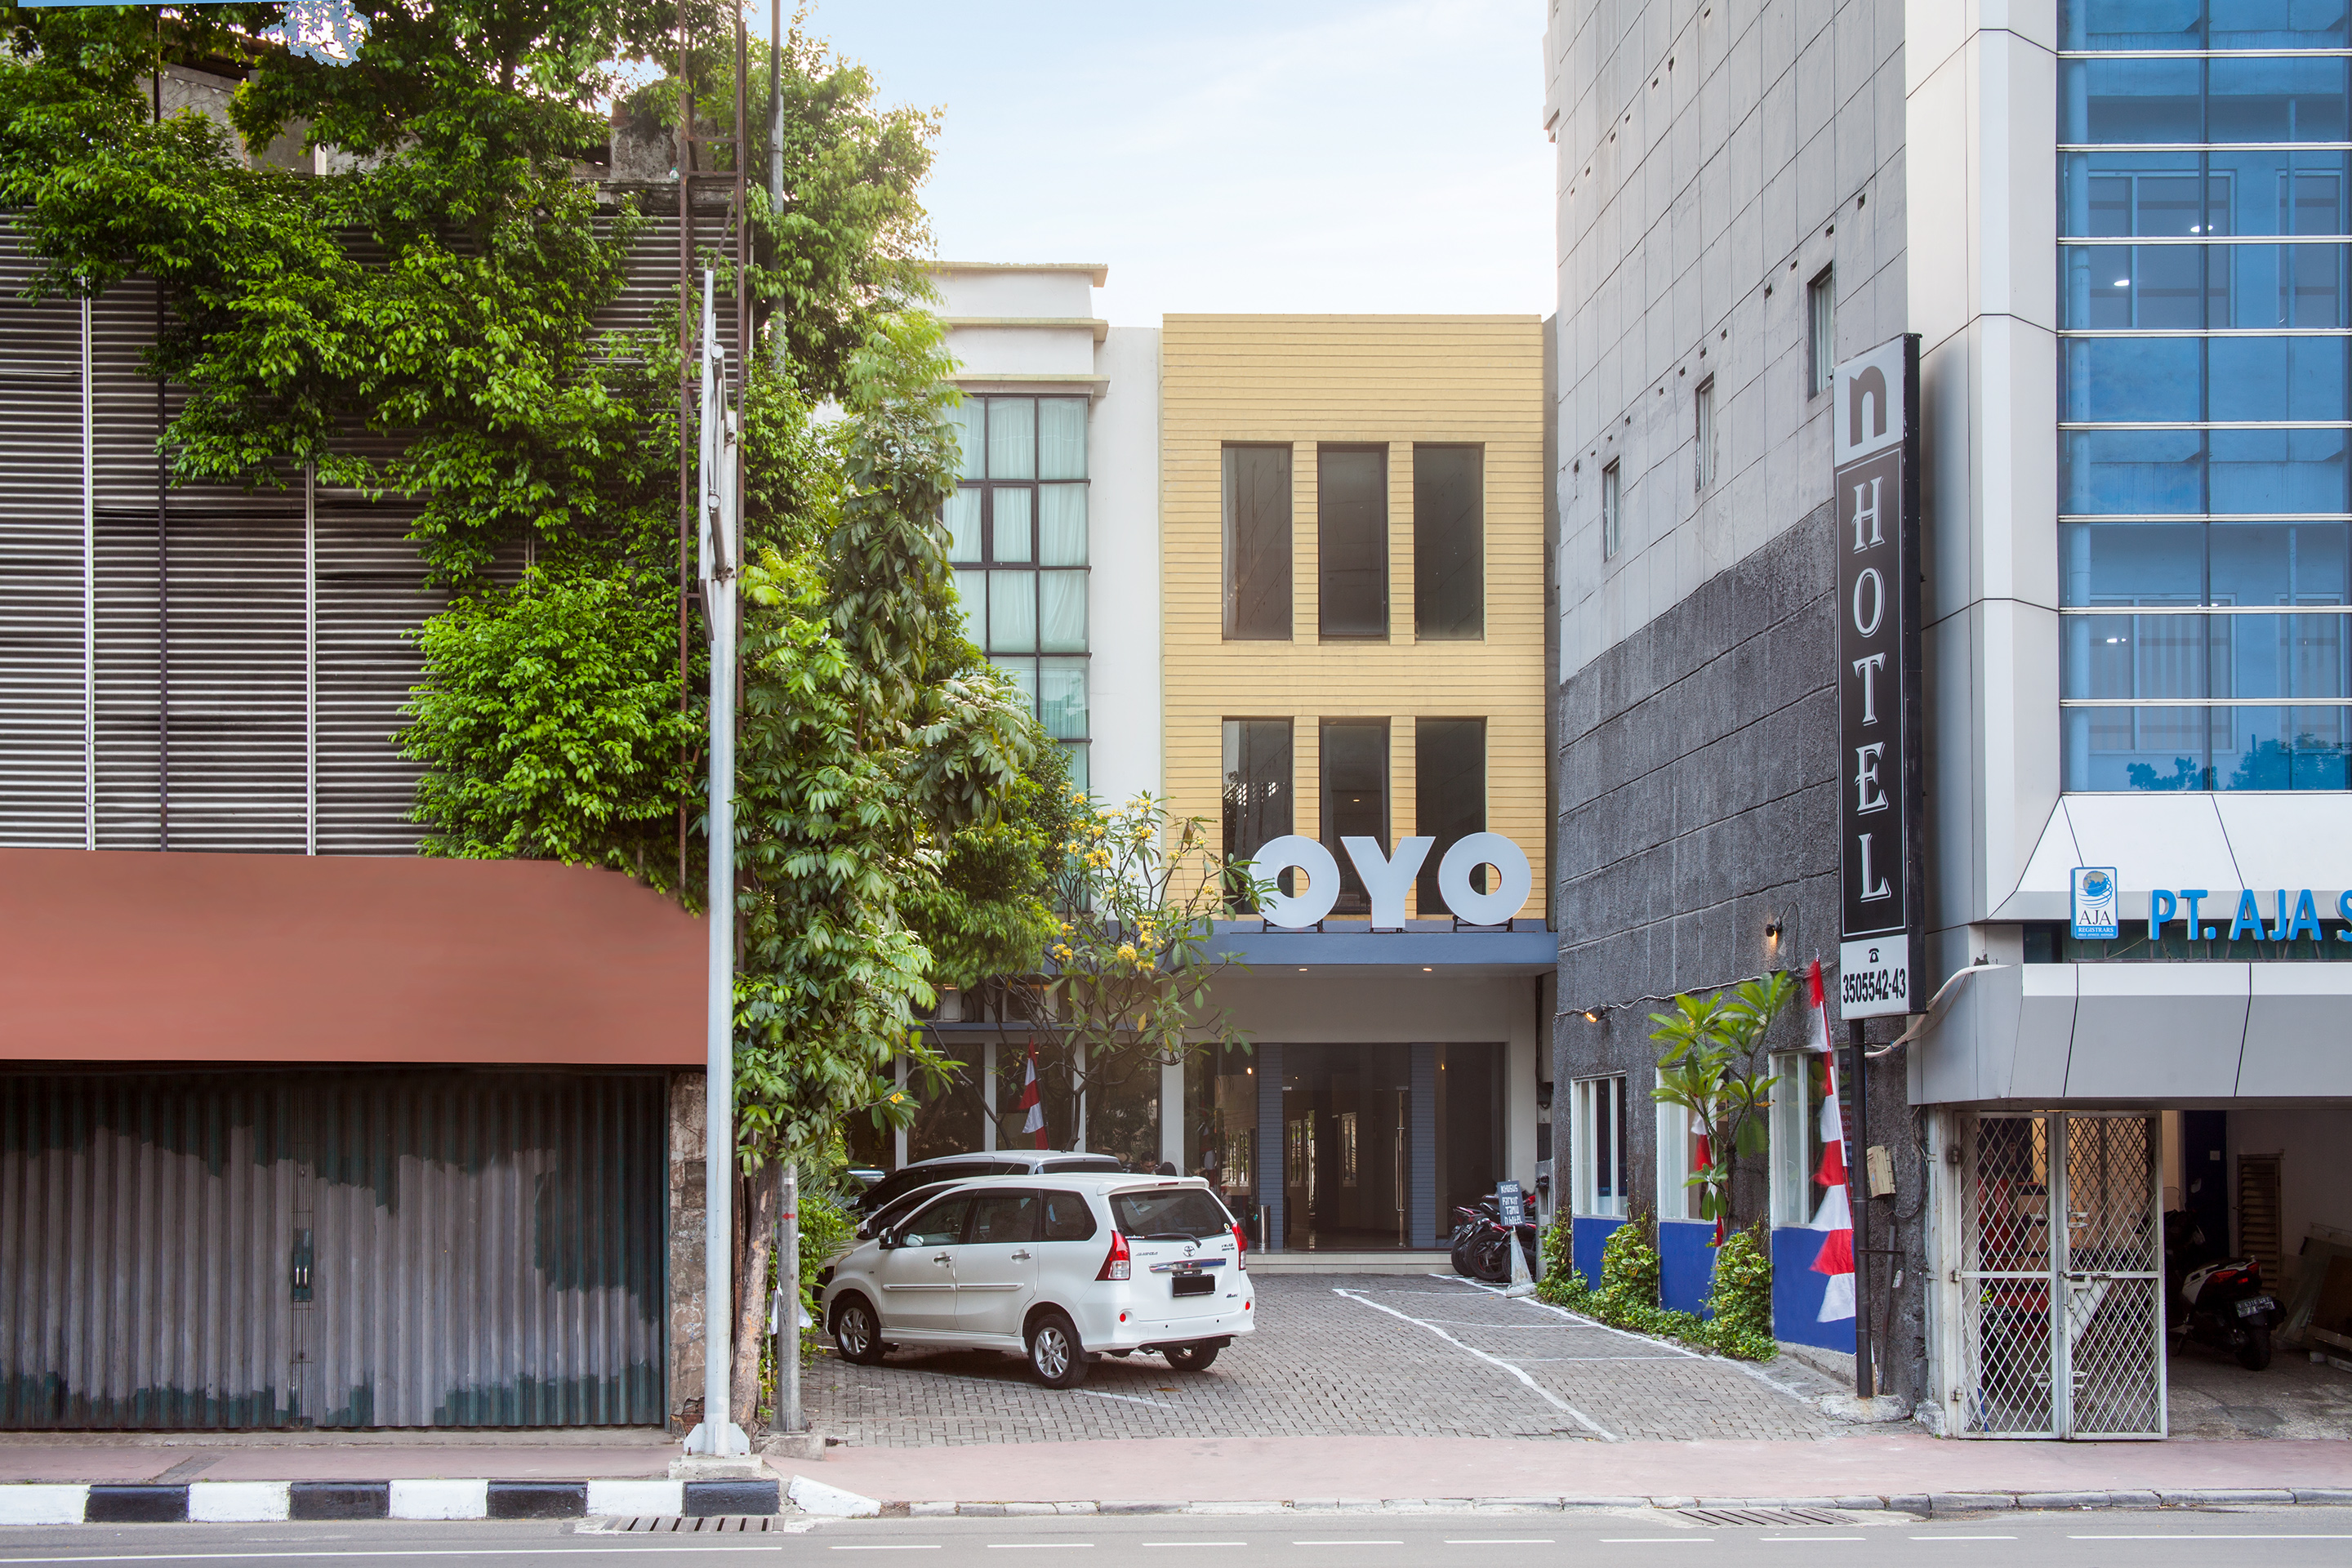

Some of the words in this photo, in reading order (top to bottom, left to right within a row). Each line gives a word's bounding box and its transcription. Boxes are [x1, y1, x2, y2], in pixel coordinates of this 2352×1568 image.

[1850, 366, 1886, 447] n
[1851, 476, 1891, 902] HOTEL
[1247, 831, 1532, 929] OYO
[2078, 910, 2112, 924] AJA
[2148, 889, 2216, 940] PT.
[2228, 889, 2322, 940] AJA
[1842, 968, 1906, 1004] 3505542-43
[1500, 1184, 1518, 1193] KHUSUS
